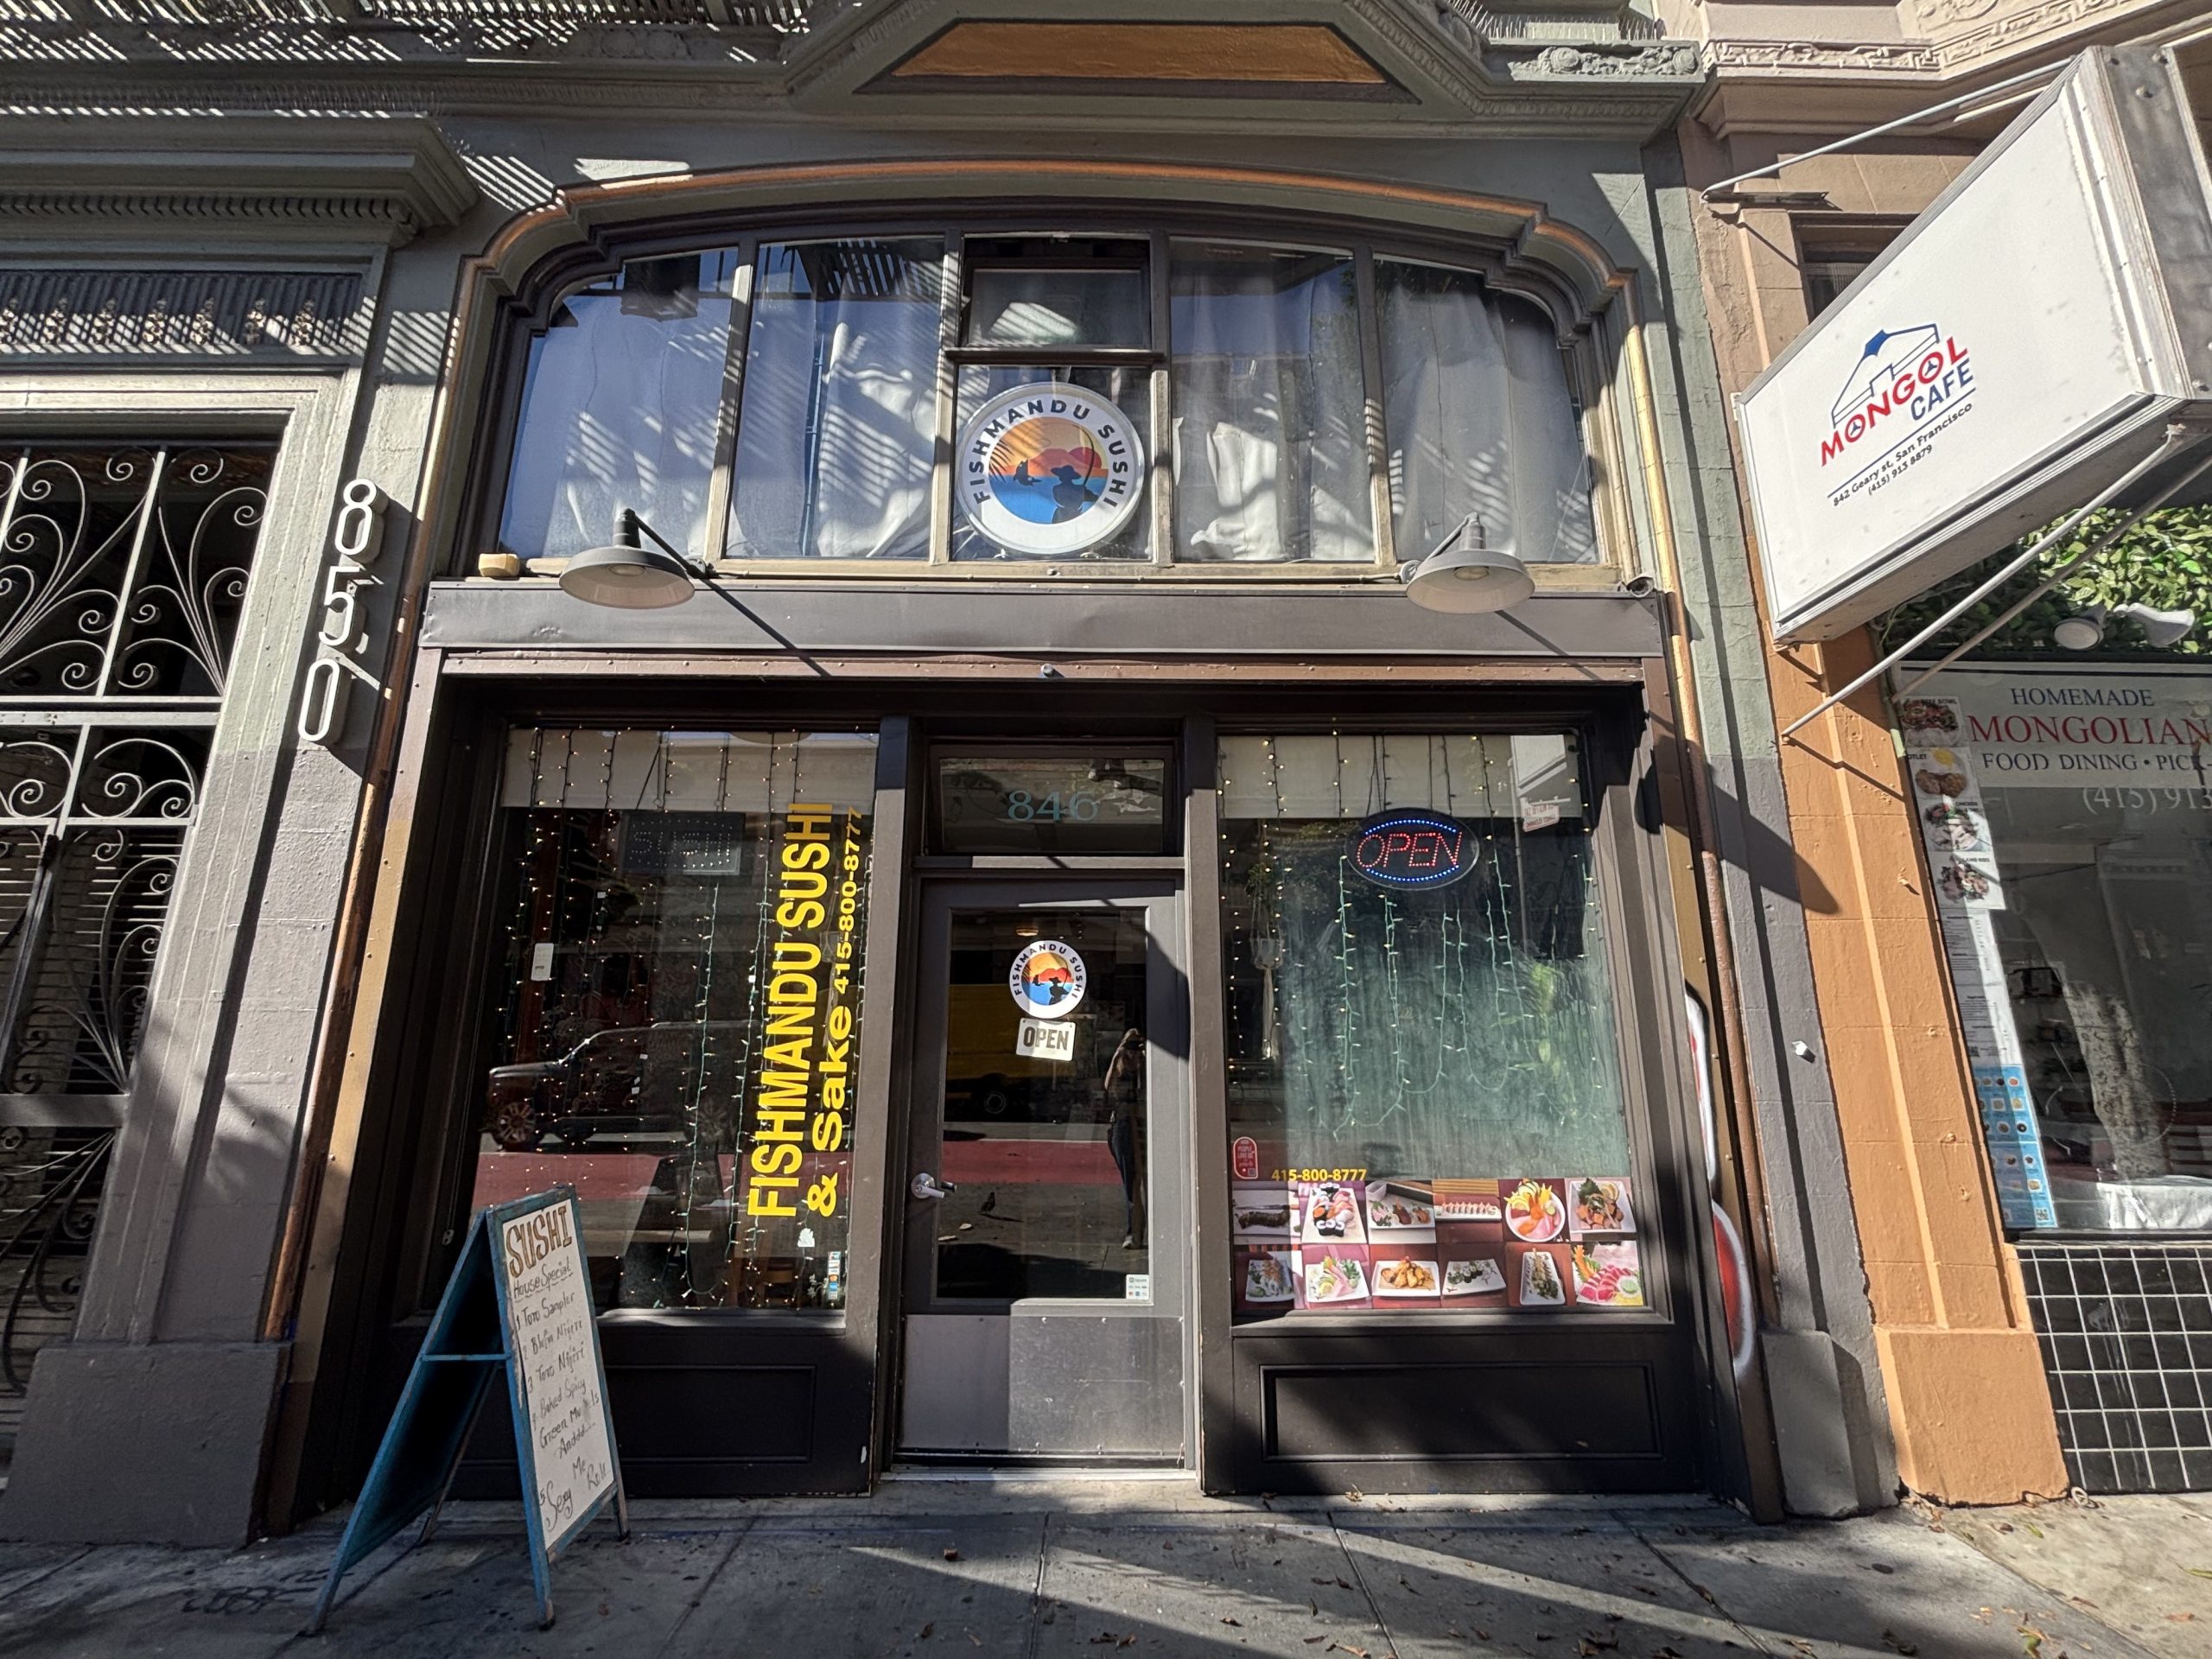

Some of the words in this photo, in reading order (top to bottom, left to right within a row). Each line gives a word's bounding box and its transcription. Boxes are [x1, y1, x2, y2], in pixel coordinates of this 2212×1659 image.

[1820, 335, 1968, 467] MONGOL
[1910, 357, 1974, 421] CAFE
[969, 399, 1090, 505] FISHMANDU
[1097, 424, 1128, 508] SUSHI
[1834, 489, 1850, 506] 842
[1852, 468, 1879, 493] Geary
[1896, 444, 1916, 461] San
[1916, 403, 1973, 447] Francisco
[1868, 474, 1891, 496] (415)
[1891, 461, 1908, 478] 913
[1910, 444, 1933, 466] 8879
[297, 479, 378, 742] 850
[2012, 688, 2155, 707] HOMEMADE
[1967, 714, 2212, 746] MONGOLIAN
[1981, 753, 2049, 772] FOOD
[2059, 753, 2138, 771] DINING
[1007, 790, 1099, 822] 846
[2082, 787, 2158, 815] (415)
[776, 803, 833, 929] SUSHI
[1356, 830, 1464, 868] OPEN
[834, 806, 862, 995] 415-800-8777
[1013, 944, 1066, 995] FISHMANDU
[1070, 957, 1084, 998] SUSHI
[1023, 1027, 1070, 1051] OPEN
[747, 942, 822, 1217] FISHMANDU
[812, 1005, 852, 1152] Sake
[807, 1172, 838, 1217] &
[1271, 1169, 1368, 1181] 415-800-8777
[506, 1205, 572, 1278] SUSHI
[513, 1275, 540, 1298] House
[541, 1255, 575, 1291] Special
[542, 1293, 575, 1319] Sampler
[540, 1419, 568, 1449] Green
